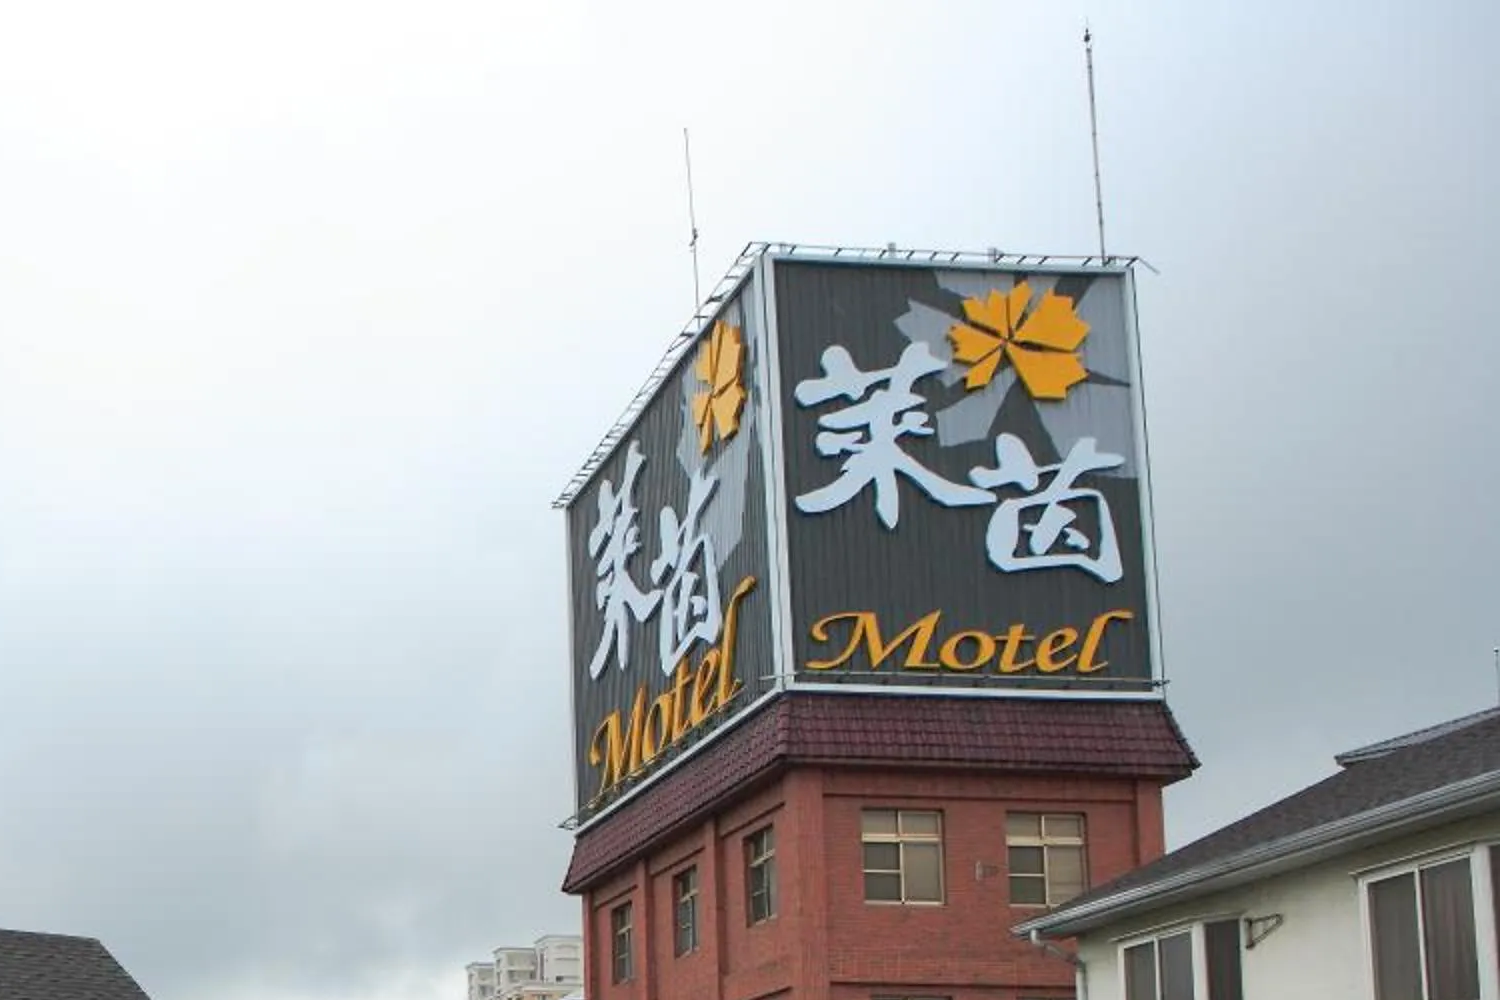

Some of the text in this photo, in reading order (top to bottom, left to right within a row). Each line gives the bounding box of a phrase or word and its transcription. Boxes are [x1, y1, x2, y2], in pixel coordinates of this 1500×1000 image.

[794, 342, 1126, 583] 萊茵
[589, 575, 757, 796] Motel
[805, 608, 1135, 674] Motel
